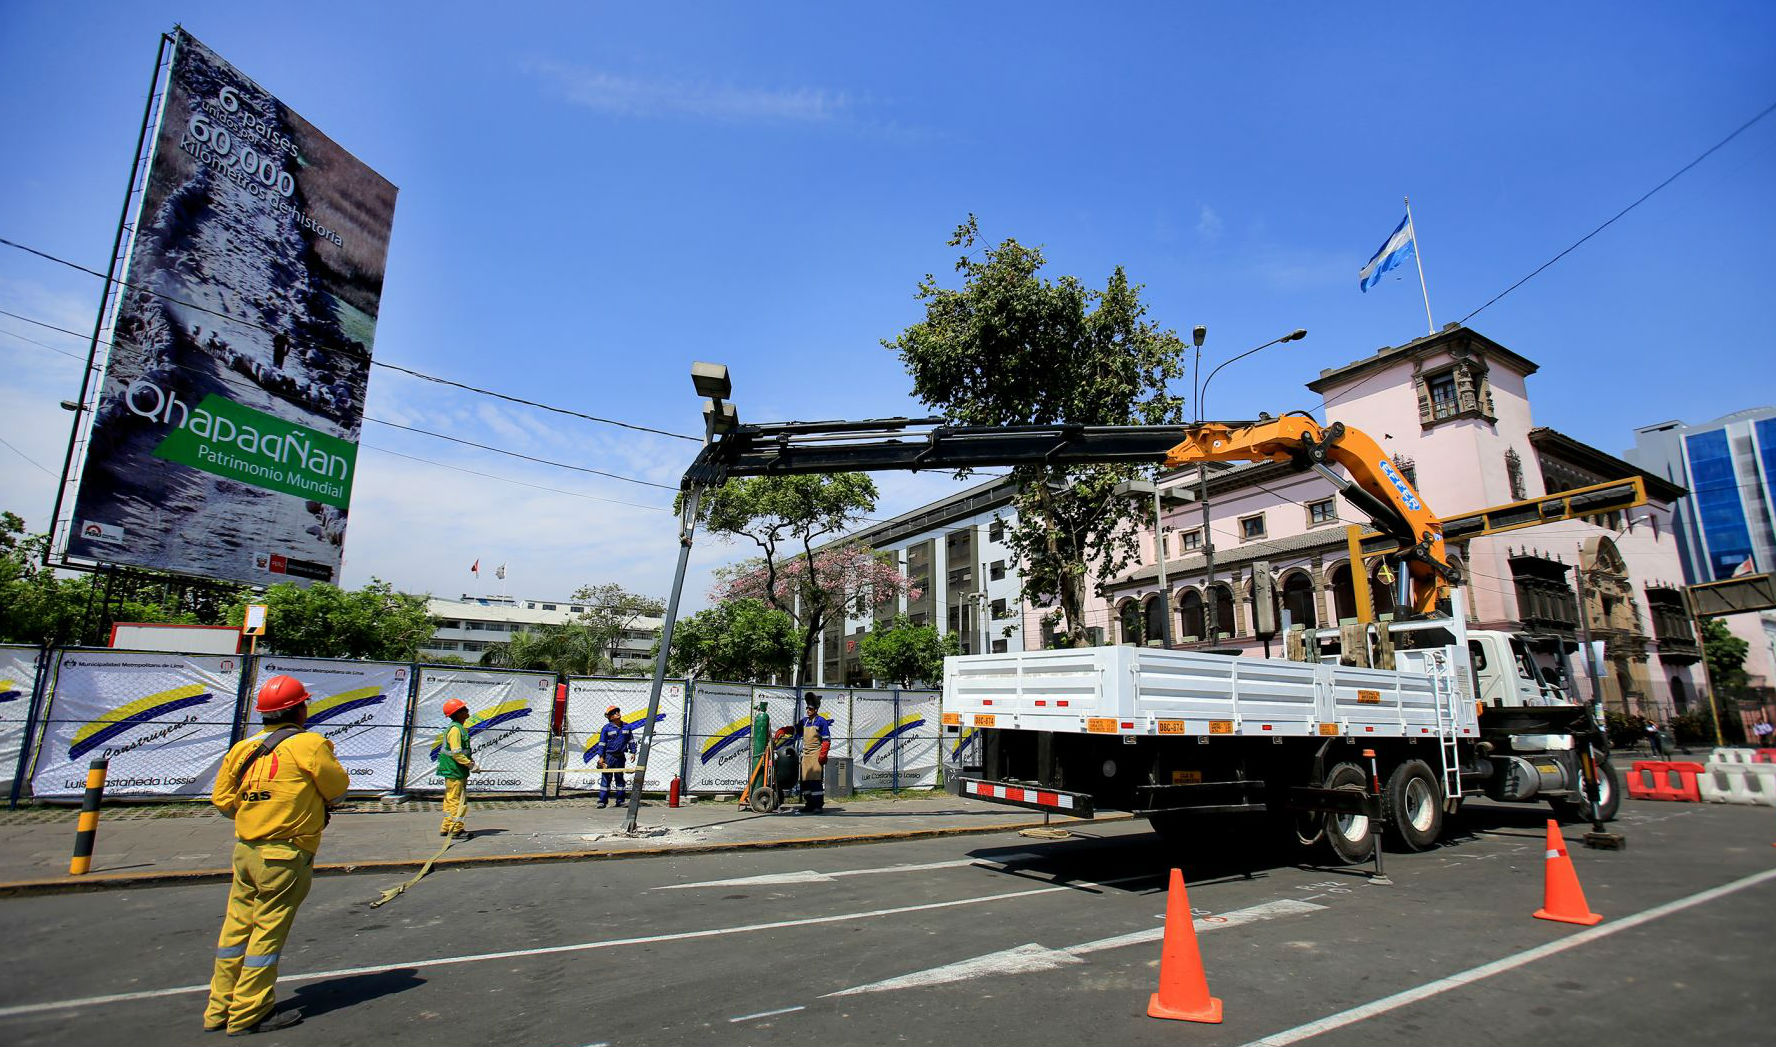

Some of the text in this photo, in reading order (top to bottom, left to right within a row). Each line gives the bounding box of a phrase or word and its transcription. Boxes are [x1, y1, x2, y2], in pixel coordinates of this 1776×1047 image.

[202, 102, 259, 145] unidos por
[219, 86, 299, 158] 6 países
[190, 115, 295, 198] 60,000
[269, 193, 288, 213] de
[290, 206, 343, 247] historia
[199, 444, 343, 498] Patrimonio Mundial
[103, 715, 198, 760] Construyendo
[324, 713, 374, 738] truyendo
[472, 726, 521, 754] struyendo
[876, 733, 919, 764] Constyendo
[65, 776, 197, 789] Luis astañeda Lossio
[429, 778, 522, 786] Luis añeda Lossio
[701, 778, 748, 786] Luis Castañed
